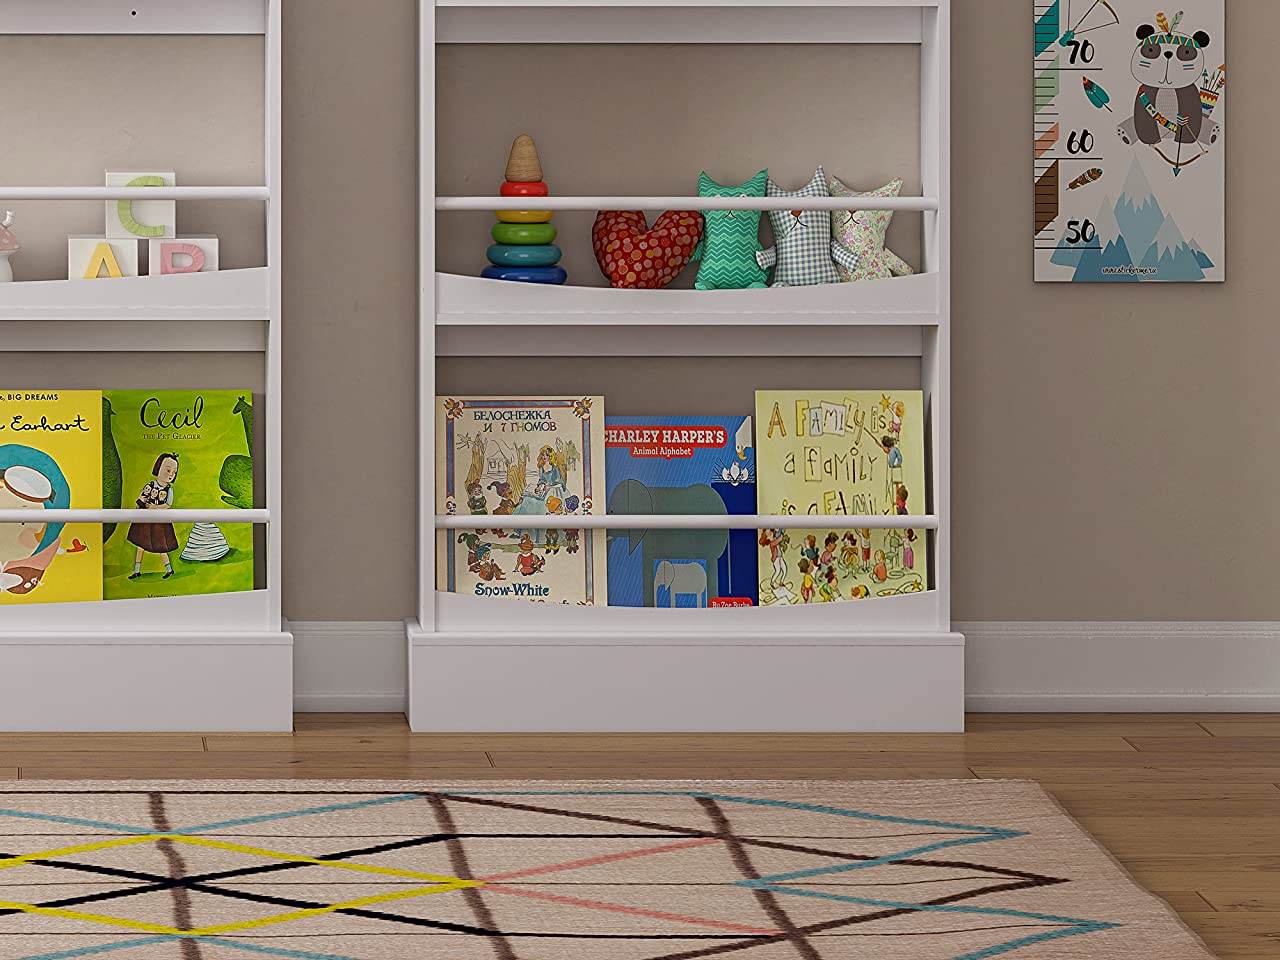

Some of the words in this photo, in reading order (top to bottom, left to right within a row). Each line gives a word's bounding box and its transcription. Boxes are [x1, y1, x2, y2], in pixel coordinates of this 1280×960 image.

[1066, 40, 1095, 65] 70
[1066, 130, 1095, 155] 60
[117, 175, 165, 237] C
[1066, 219, 1095, 244] 50
[10, 414, 90, 432] Earhart
[140, 396, 204, 429] Cecil
[473, 410, 552, 421] БЕЛОСНЕЖКА
[767, 402, 787, 439] A
[873, 409, 887, 430] is
[482, 423, 493, 433] И
[500, 422, 507, 433] 7
[510, 421, 557, 433] ГНОМОВ
[662, 429, 725, 444] HARPER'S
[633, 447, 658, 455] Animal
[660, 447, 692, 457] Alphabet
[783, 452, 796, 475] a
[474, 582, 550, 597] Snow-White
